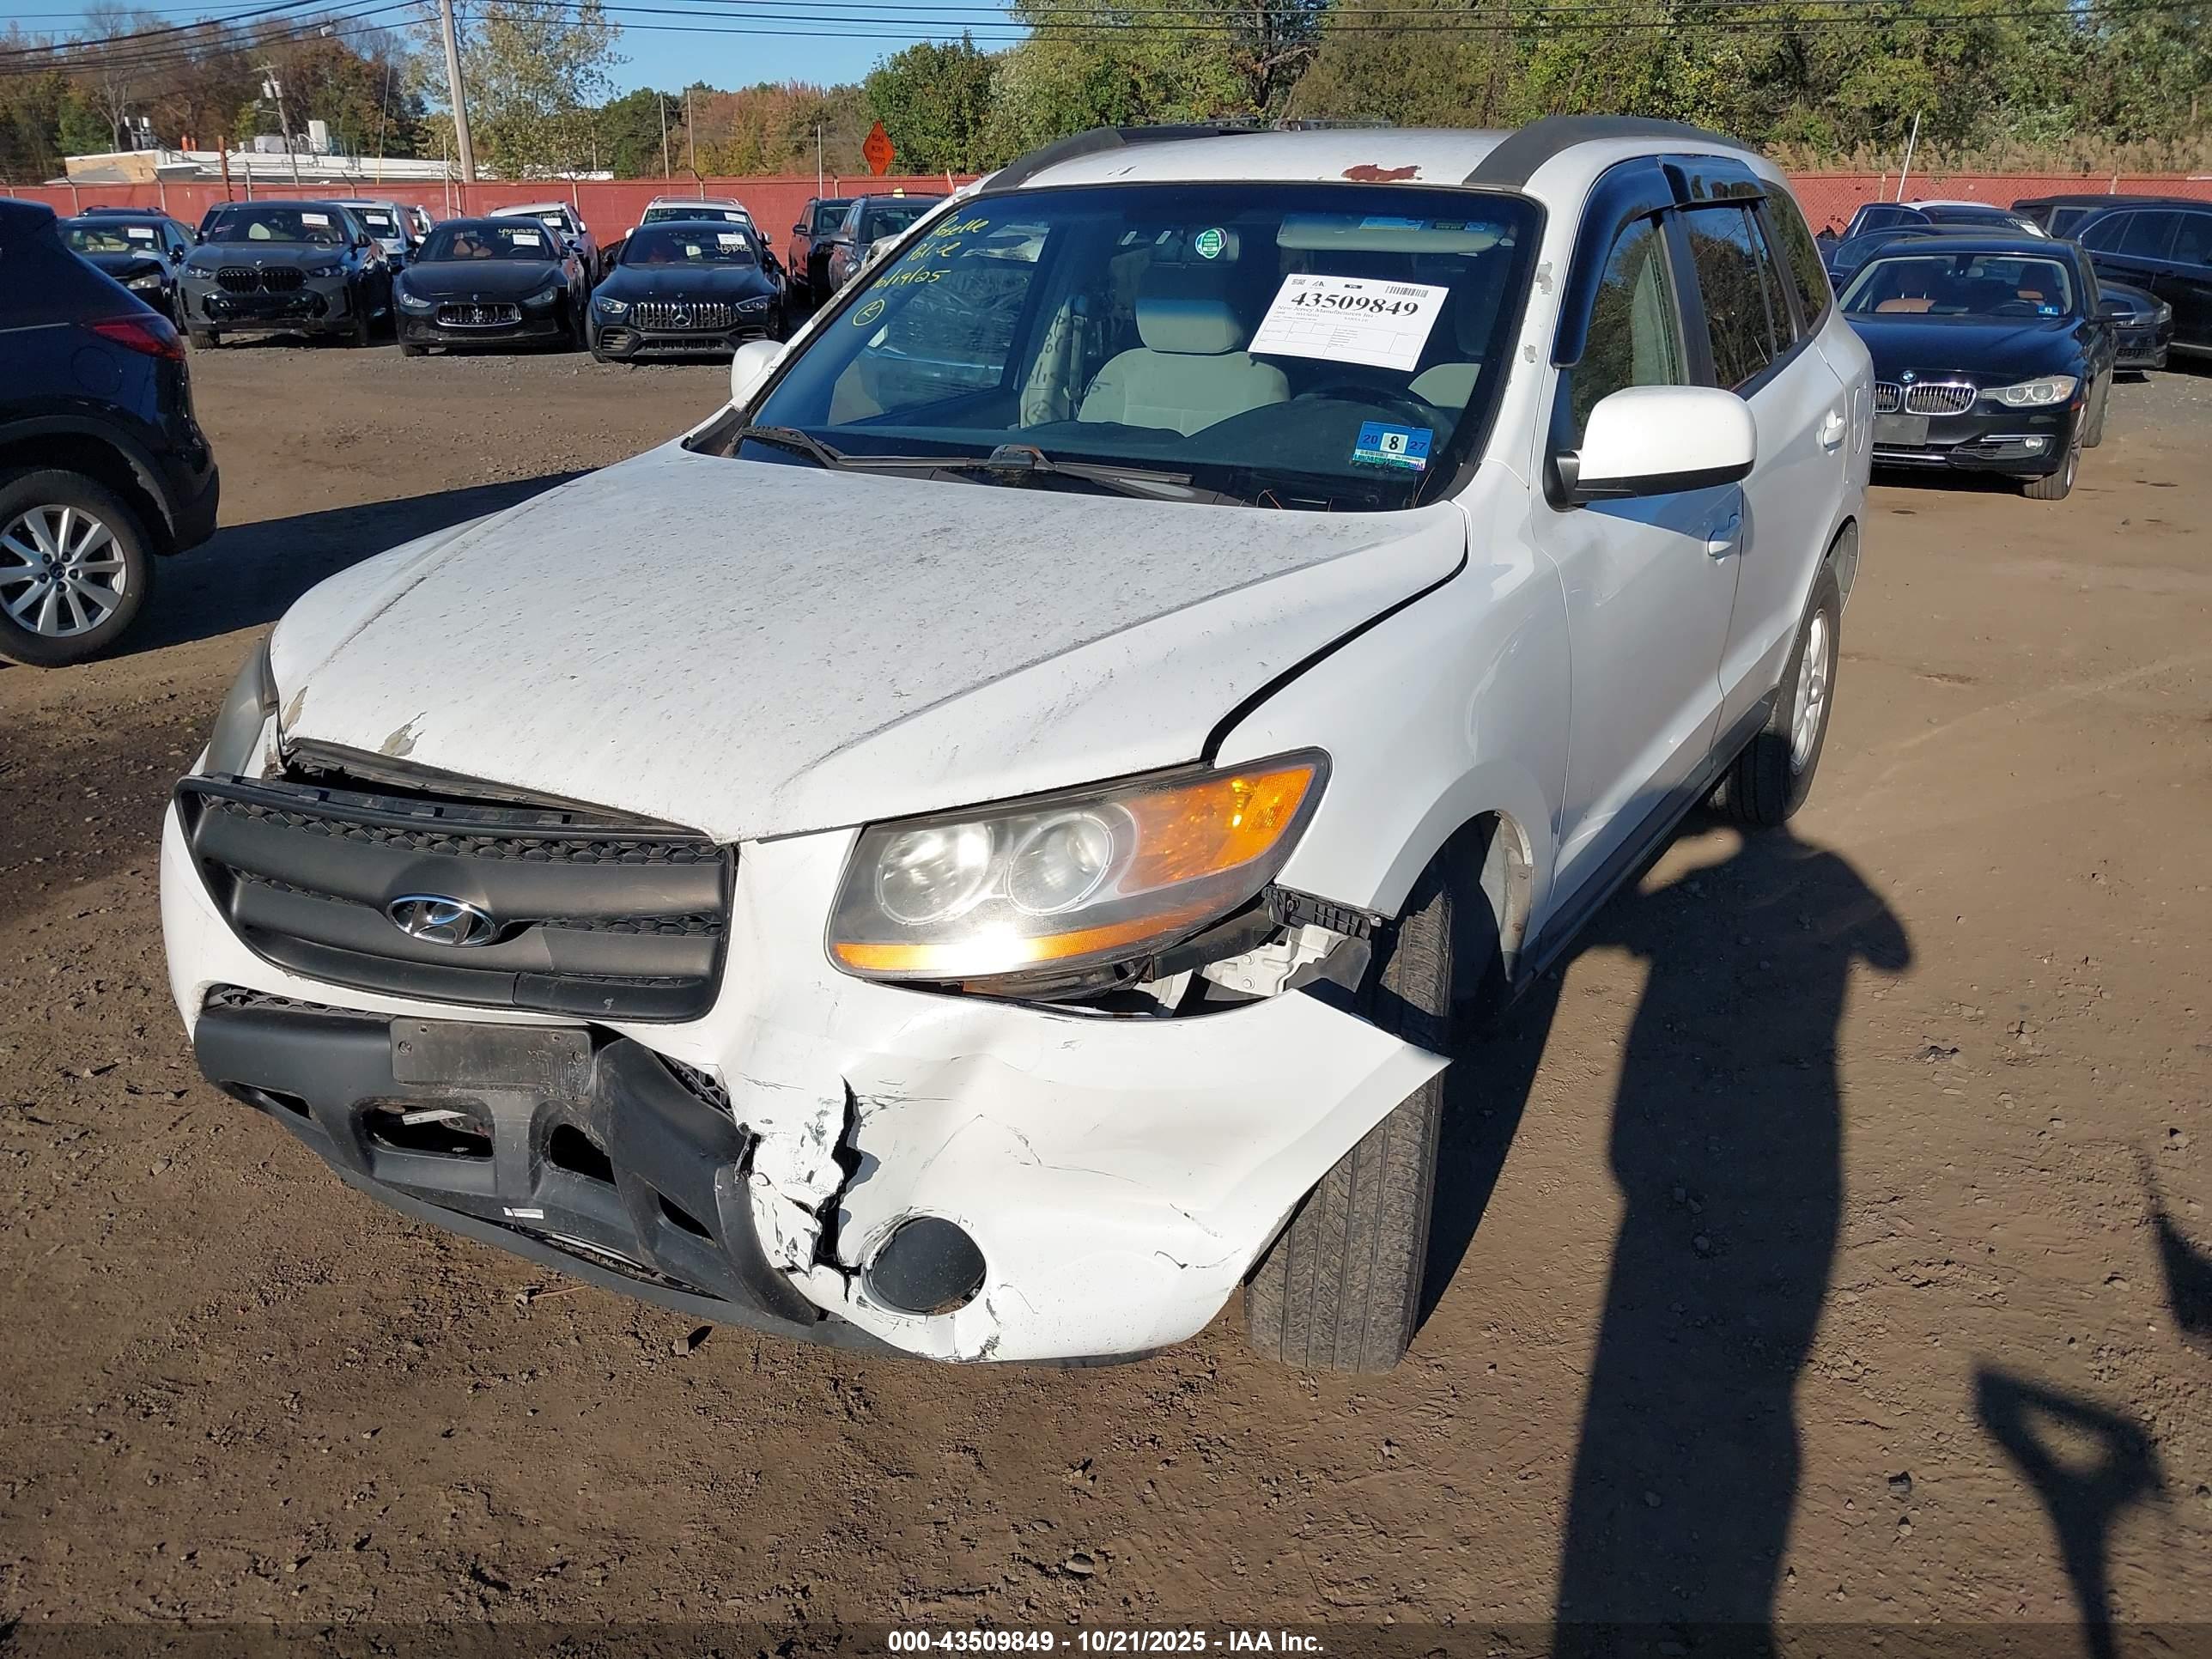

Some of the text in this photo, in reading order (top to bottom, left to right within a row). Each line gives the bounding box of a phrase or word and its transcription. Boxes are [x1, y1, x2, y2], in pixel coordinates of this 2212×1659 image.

[907, 241, 962, 261] Police
[869, 264, 951, 290] 10/19/25
[1291, 291, 1419, 318] 43509849
[1363, 434, 1427, 451] 20 8 27
